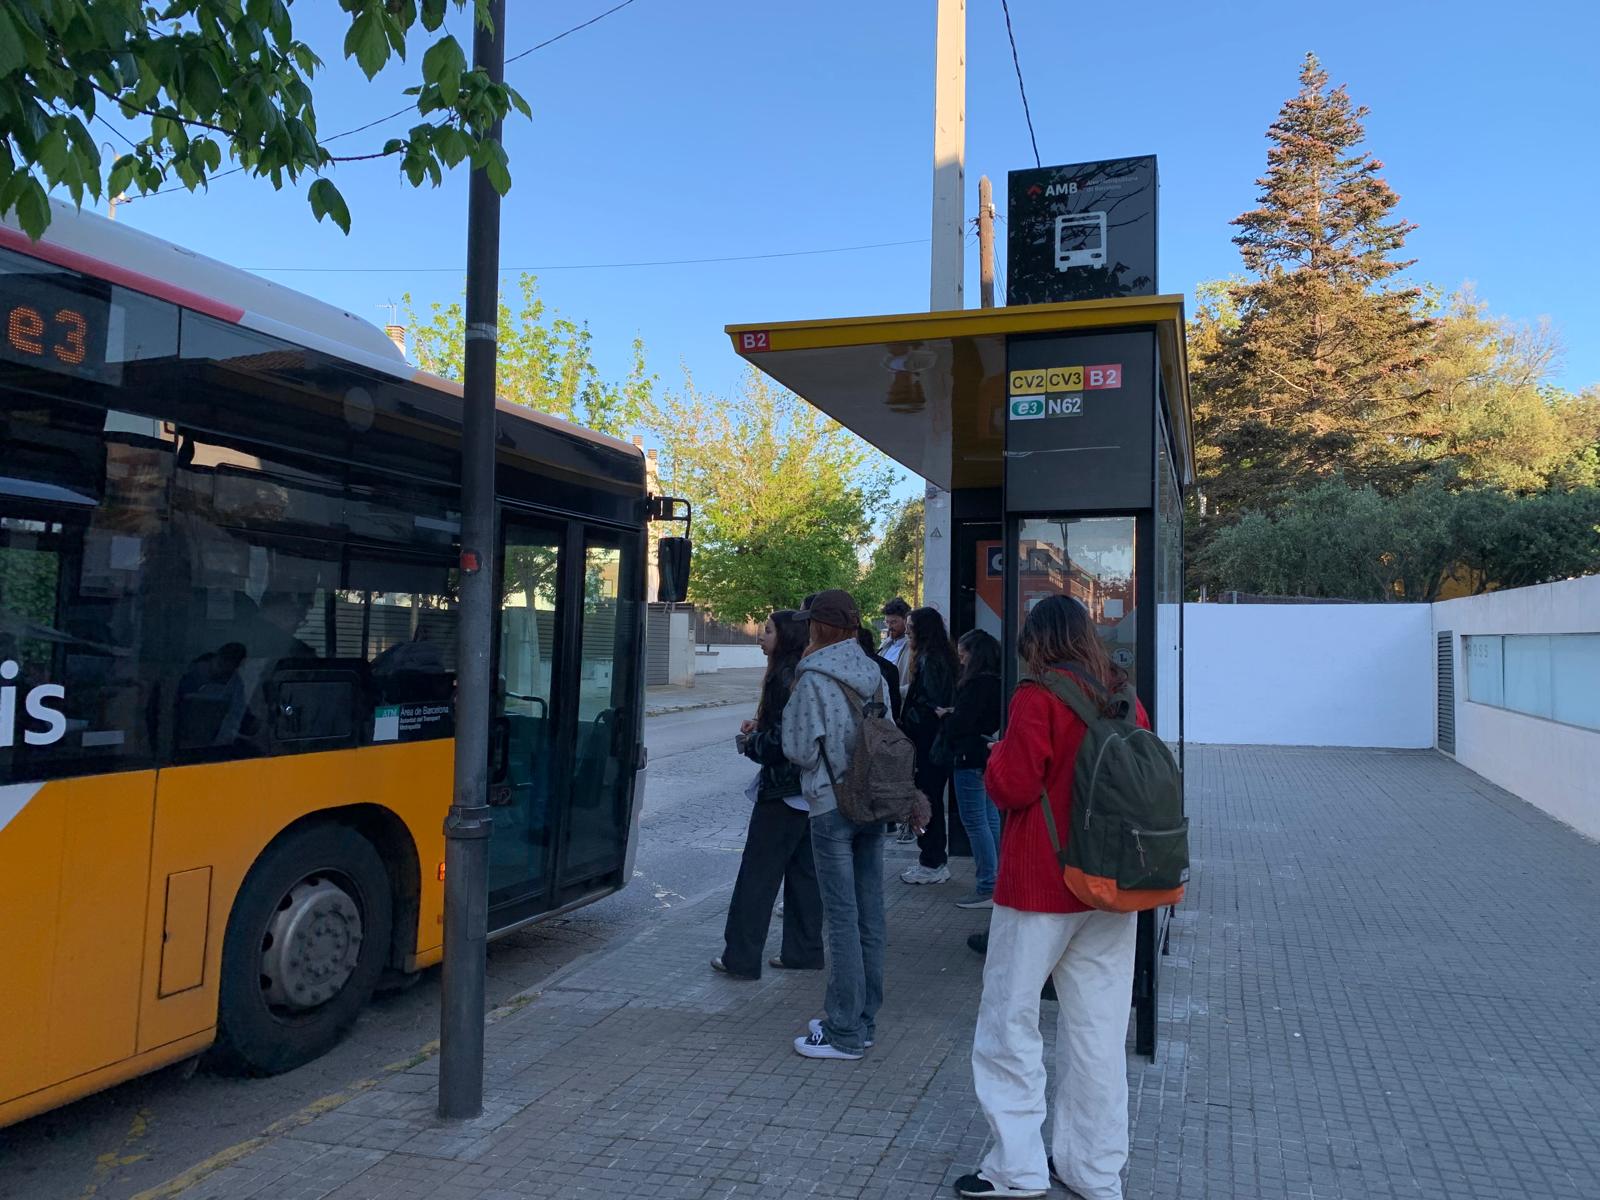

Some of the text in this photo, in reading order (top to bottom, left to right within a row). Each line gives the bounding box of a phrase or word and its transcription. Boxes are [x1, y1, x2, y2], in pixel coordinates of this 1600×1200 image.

[1045, 182, 1078, 197] AMB
[9, 306, 87, 364] e3
[743, 332, 767, 349] B2
[1012, 369, 1117, 389] CV2 CV3 B2
[1018, 398, 1081, 415] e3 N62
